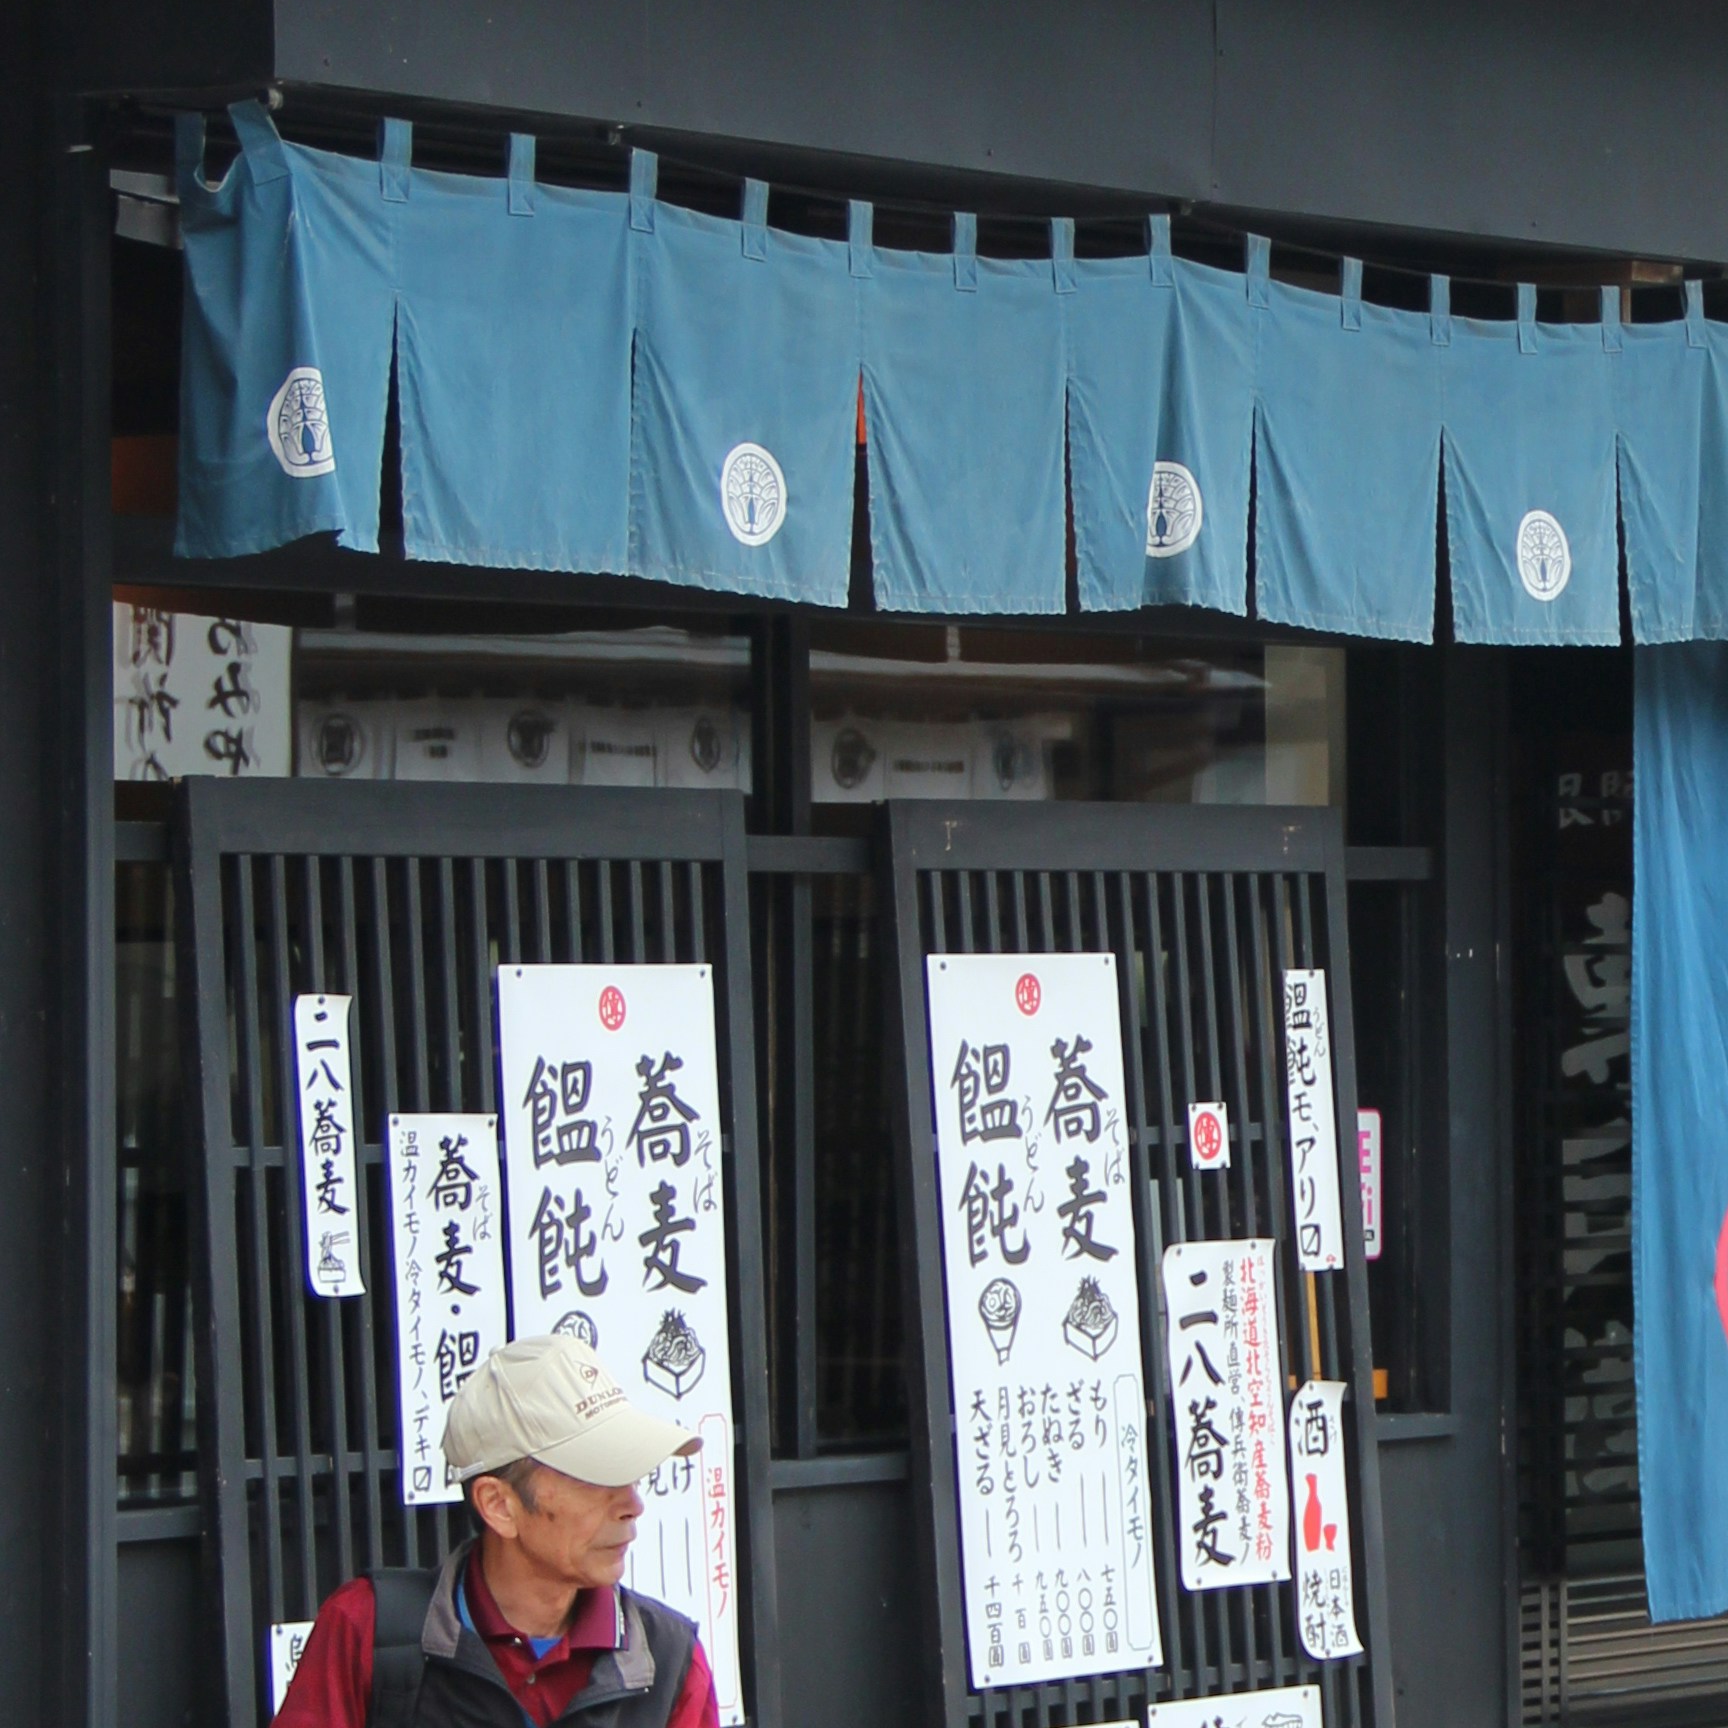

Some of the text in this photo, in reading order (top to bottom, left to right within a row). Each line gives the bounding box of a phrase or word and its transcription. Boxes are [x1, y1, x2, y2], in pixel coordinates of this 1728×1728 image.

[306, 1012, 350, 1216] 二八蕎麦
[626, 1051, 707, 1294] 蕎麦
[694, 1129, 717, 1213] そば
[951, 1039, 1031, 1268] 饂飩
[1021, 1096, 1044, 1213] うどん
[1044, 1035, 1119, 1261] 蕎麦
[1105, 1109, 1125, 1187] そば
[523, 1055, 609, 1300] 饂飩
[601, 1116, 624, 1241] うどん
[970, 1389, 994, 1496] 天ざる
[997, 1386, 1023, 1563] 月見とろろ
[1017, 1384, 1040, 1488] おろし
[1040, 1383, 1064, 1483] たぬき
[1066, 1378, 1085, 1450] ざる
[1089, 1379, 1107, 1448] もり
[1178, 1270, 1236, 1567] 二八蕎麦
[1294, 1398, 1328, 1458] 酒
[707, 1466, 730, 1619] 温カイモノ
[1120, 1423, 1144, 1569] 冷タイモノ
